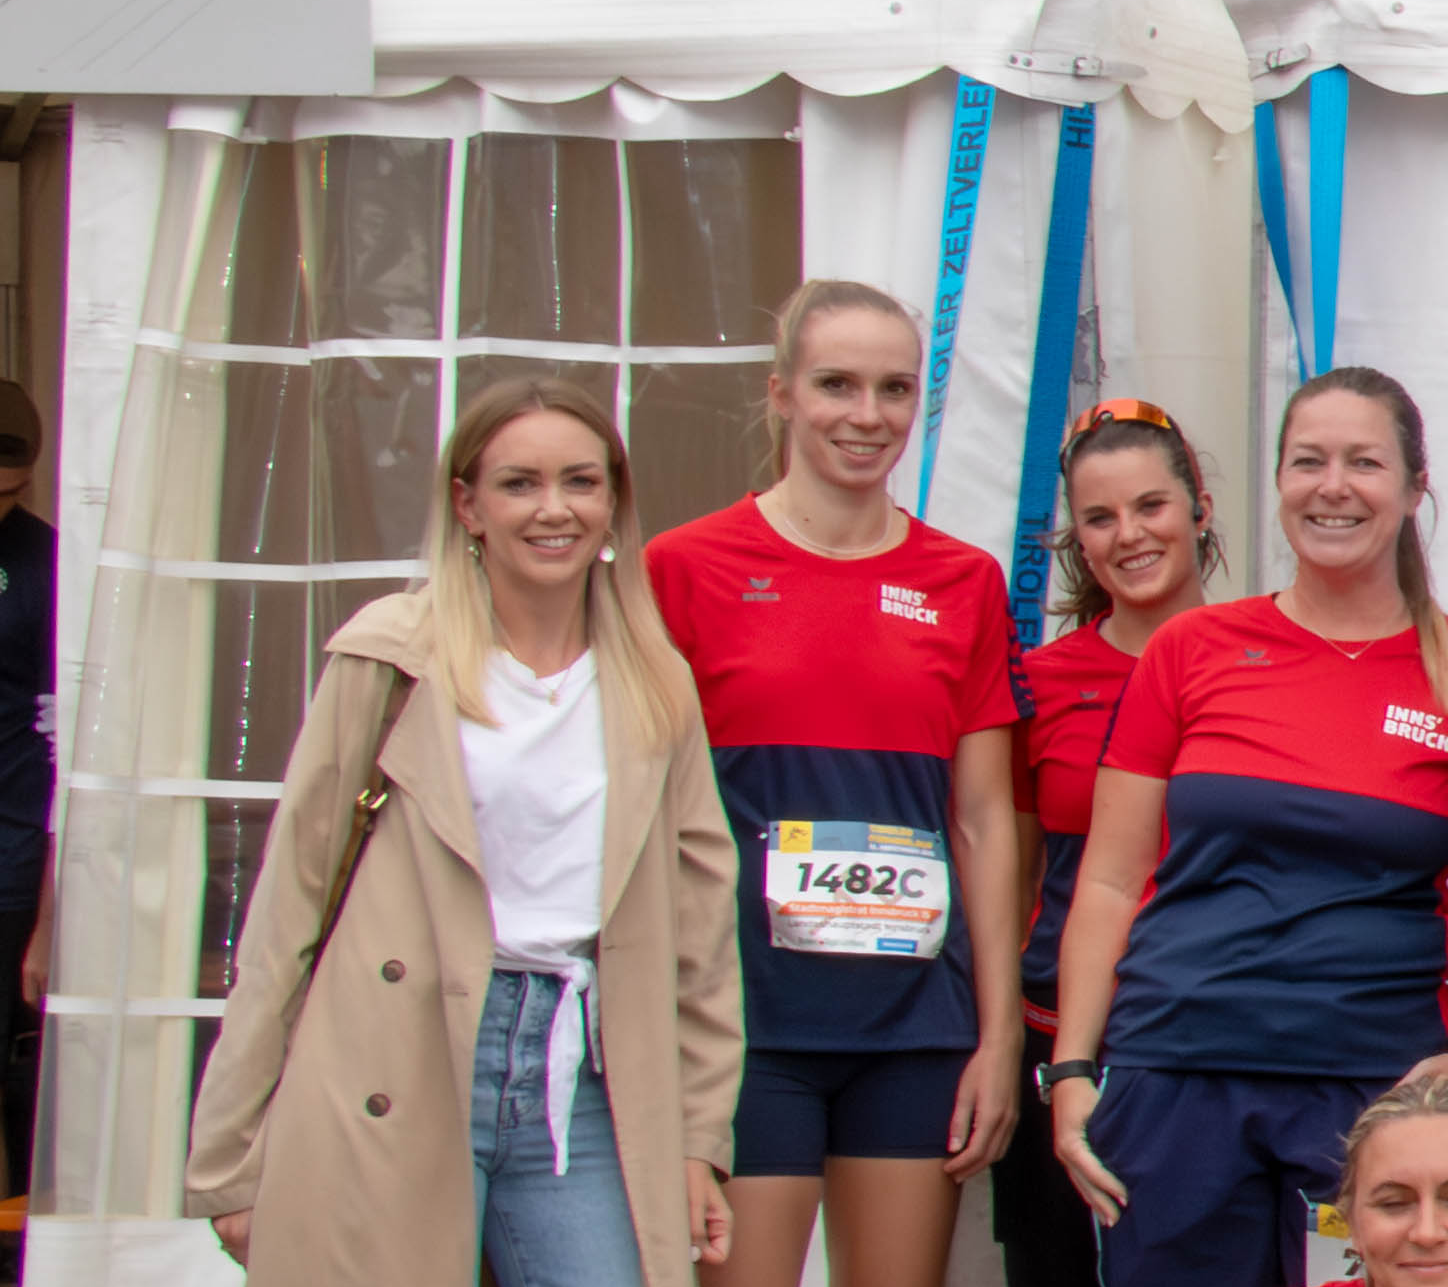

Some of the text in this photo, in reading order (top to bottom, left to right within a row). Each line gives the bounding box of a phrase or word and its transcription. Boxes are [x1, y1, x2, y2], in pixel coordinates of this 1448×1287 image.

[1013, 512, 1051, 651] TIROLE
[880, 598, 938, 626] BRUCK
[797, 863, 927, 898] 1482C
